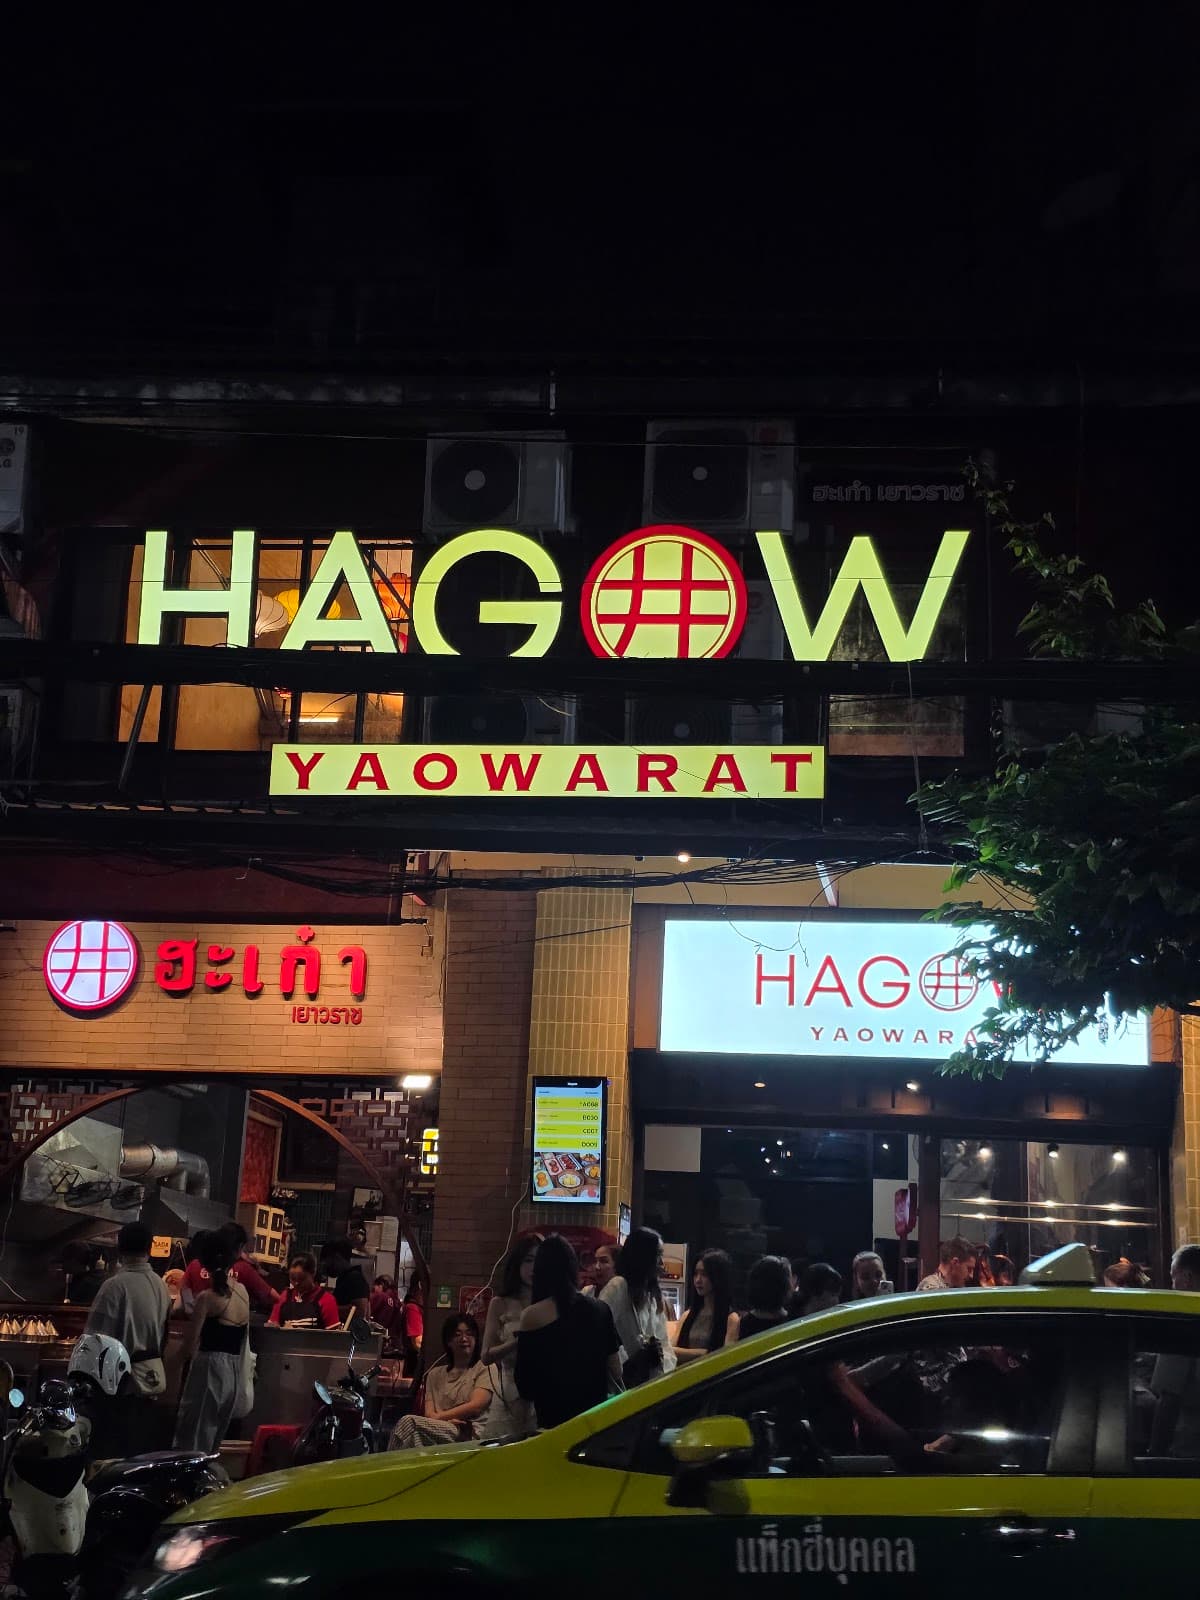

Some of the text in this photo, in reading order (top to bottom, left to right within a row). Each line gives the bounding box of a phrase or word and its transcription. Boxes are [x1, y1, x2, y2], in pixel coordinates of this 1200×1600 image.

[286, 752, 813, 793] YAOWARAT
[154, 925, 368, 996] ฮะเก๋า
[736, 1516, 916, 1585] แท็กซี่บุคคล
